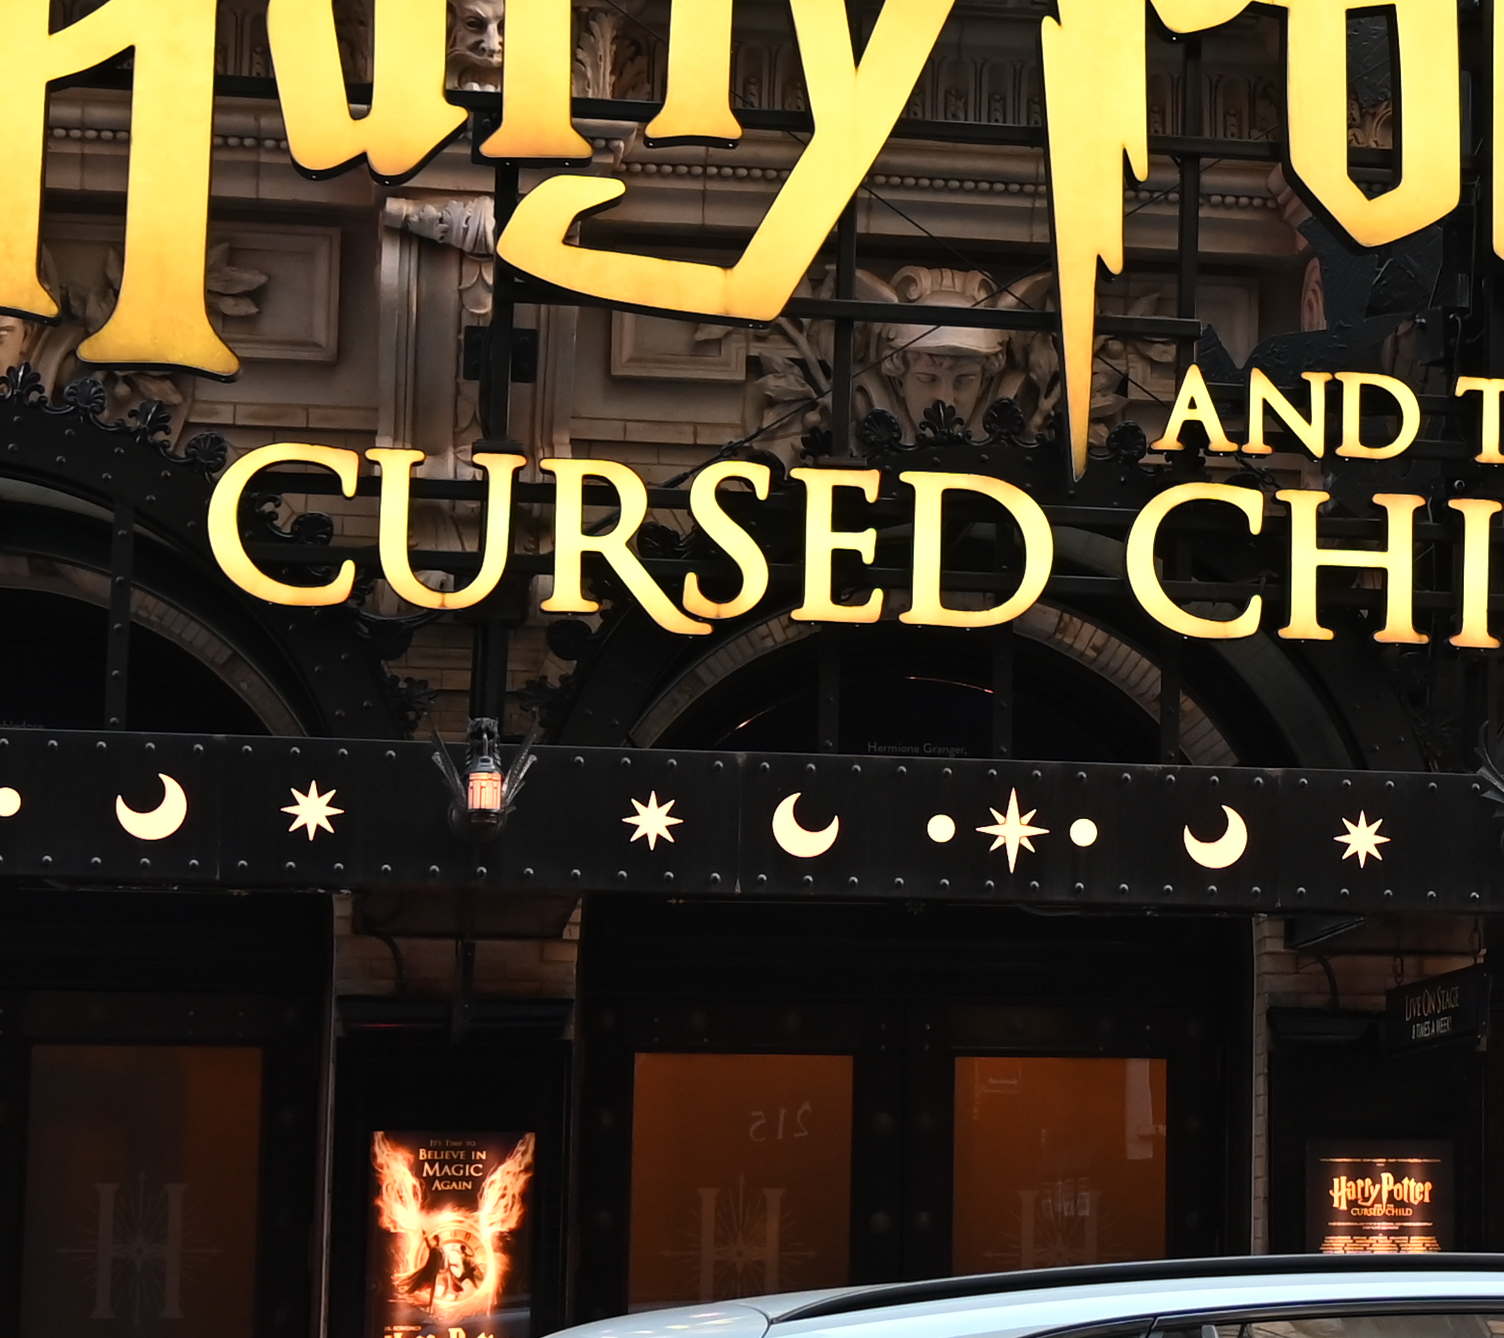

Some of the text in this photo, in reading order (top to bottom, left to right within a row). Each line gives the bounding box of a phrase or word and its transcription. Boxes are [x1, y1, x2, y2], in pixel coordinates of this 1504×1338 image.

[1152, 363, 1422, 461] AND
[206, 441, 1055, 636] CURSED
[418, 1148, 487, 1161] BELIEVE IN
[422, 1161, 484, 1177] MAGIC
[431, 1179, 473, 1191] AGAIN
[1329, 1172, 1433, 1212] Harry Potter
[1385, 1207, 1413, 1217] CHILD
